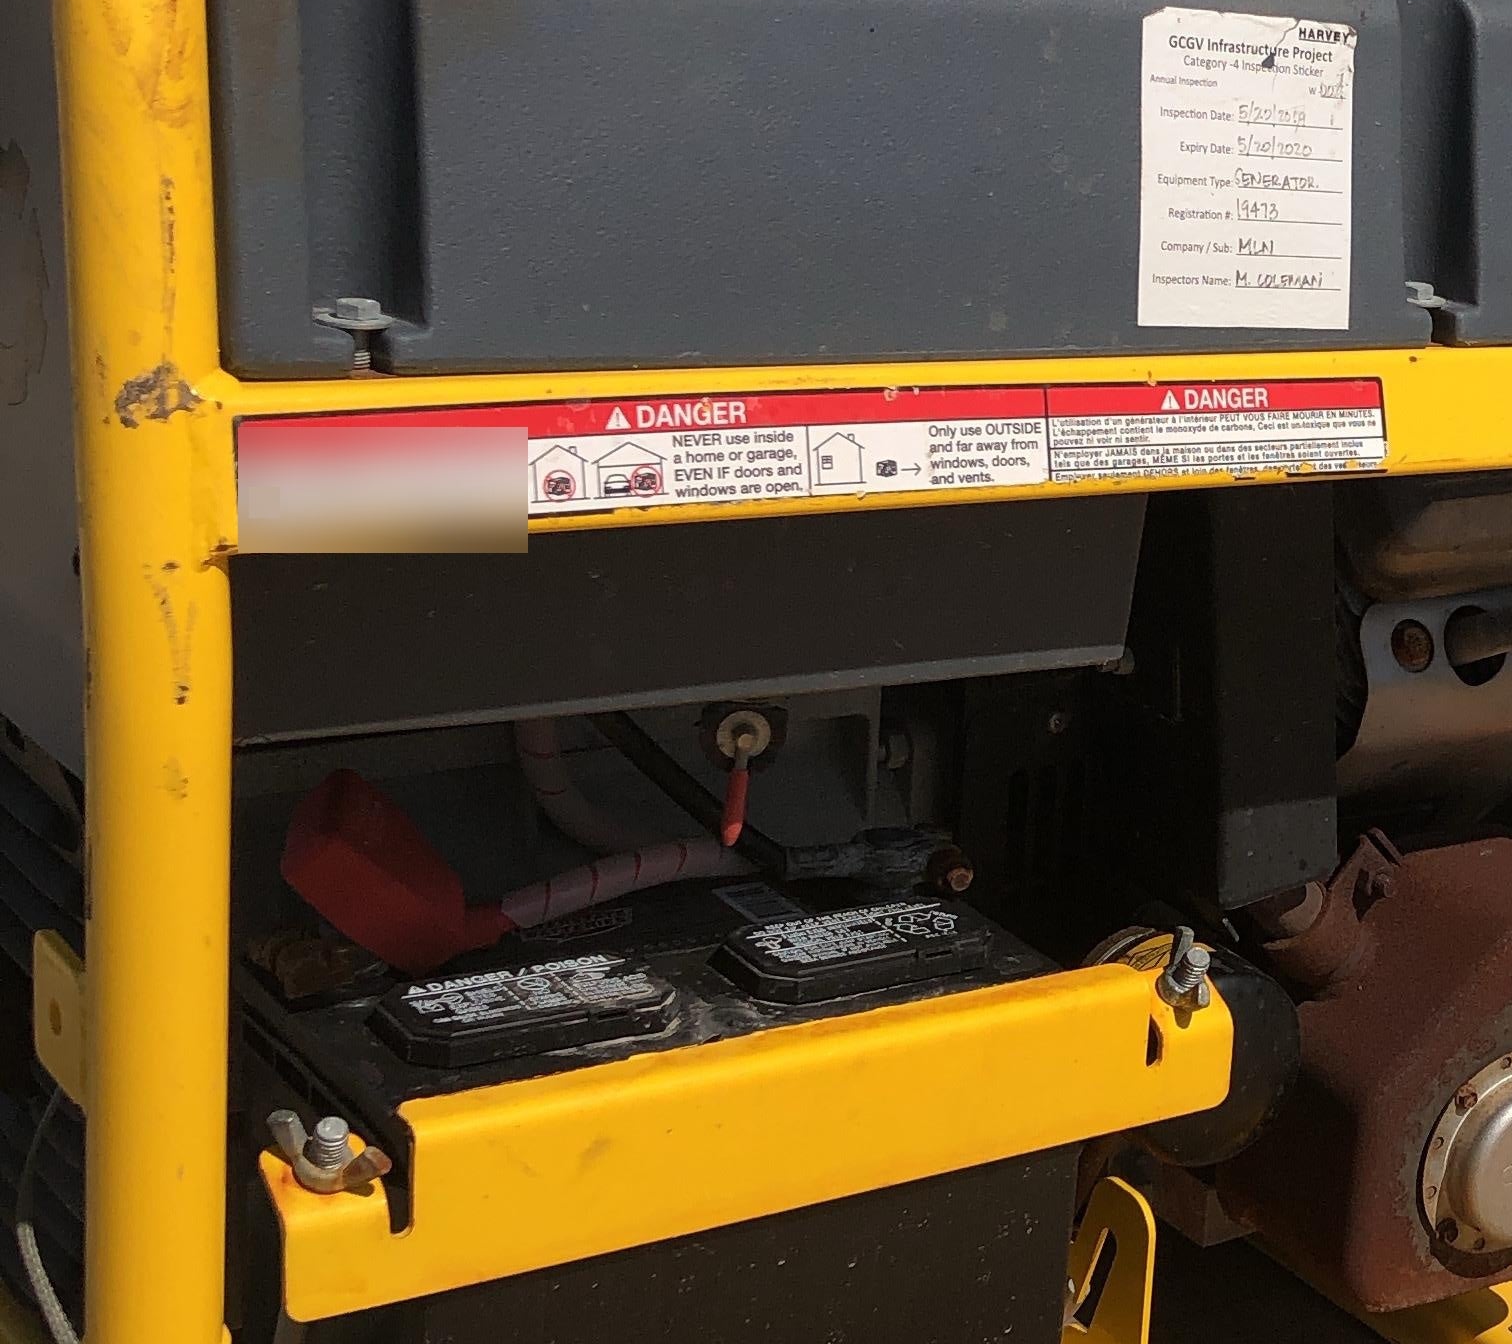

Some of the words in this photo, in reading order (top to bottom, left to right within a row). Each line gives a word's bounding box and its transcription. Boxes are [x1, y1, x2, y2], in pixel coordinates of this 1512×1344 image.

[1298, 27, 1350, 45] HARVEY
[1169, 35, 1204, 51] GCGV
[1207, 38, 1289, 57] Infrastructure
[1293, 46, 1333, 63] Project
[1183, 55, 1227, 71] Category
[1293, 64, 1324, 78] Sticker
[1149, 74, 1177, 85] Annual
[1178, 76, 1218, 88] Inspection
[1159, 106, 1208, 120] Inspection
[1210, 110, 1235, 122] Date:
[1179, 141, 1208, 155] Expiry
[1209, 142, 1234, 155] Date:
[1157, 173, 1208, 187] Equipment
[1168, 207, 1223, 221] Registration
[1224, 210, 1234, 220] #:
[1236, 198, 1280, 221] 19473
[1160, 240, 1205, 254] Company
[1205, 241, 1212, 253] /
[1212, 242, 1233, 254] Sub:
[1152, 273, 1201, 286] Inspectors
[1202, 275, 1232, 287] Name:
[1184, 387, 1269, 410] DANGER
[636, 400, 747, 429] DANGER
[1052, 416, 1101, 427] L'utilisation
[1104, 416, 1123, 426] d'un
[1219, 413, 1240, 422] PEUT
[1243, 413, 1265, 421] VOUS
[1267, 411, 1290, 421] FAIRE
[1292, 411, 1324, 420] MOURIR
[1326, 411, 1337, 420] EN
[928, 425, 957, 439] Only
[960, 426, 982, 437] use
[985, 422, 1042, 435] OUTSIDE
[1119, 425, 1153, 435] contient
[1155, 425, 1163, 434] le
[1209, 423, 1219, 432] de
[1257, 421, 1275, 431] Ceci
[1277, 421, 1289, 430] est
[672, 433, 723, 448] NEVER
[725, 434, 750, 446] use
[753, 430, 794, 444] inside
[929, 441, 953, 454] and
[955, 440, 973, 453] far
[975, 440, 1008, 454] away
[1010, 438, 1039, 450] from
[1053, 436, 1084, 447] pouvez
[1086, 435, 1095, 445] ni
[1096, 434, 1113, 444] voir
[1115, 433, 1123, 444] ni
[673, 455, 682, 464] a
[685, 450, 725, 463] home
[728, 451, 743, 461] or
[746, 447, 797, 464] garage,
[1053, 449, 1103, 461] N'employer
[1105, 447, 1138, 457] JAMAIS
[1140, 446, 1160, 456] dans
[1172, 444, 1202, 455] maison
[1216, 443, 1236, 453] dans
[1237, 442, 1253, 452] des
[1254, 441, 1288, 452] secteurs
[1341, 439, 1364, 449] inclus
[930, 457, 989, 470] windows,
[991, 455, 1030, 468] doors,
[1054, 459, 1071, 469] tels
[1074, 459, 1091, 469] que
[1093, 457, 1110, 467] des
[1152, 453, 1179, 465] MÊME
[1209, 452, 1235, 463] portes
[1262, 449, 1296, 460] fenêtres
[674, 467, 713, 482] EVEN
[717, 466, 730, 480] IF
[734, 465, 774, 478] doors
[777, 463, 802, 477] and
[930, 473, 955, 485] and
[957, 471, 995, 484] vents.
[675, 484, 737, 499] windows
[740, 482, 762, 494] are
[425, 970, 513, 993] DANGER
[531, 953, 607, 974] POISON
